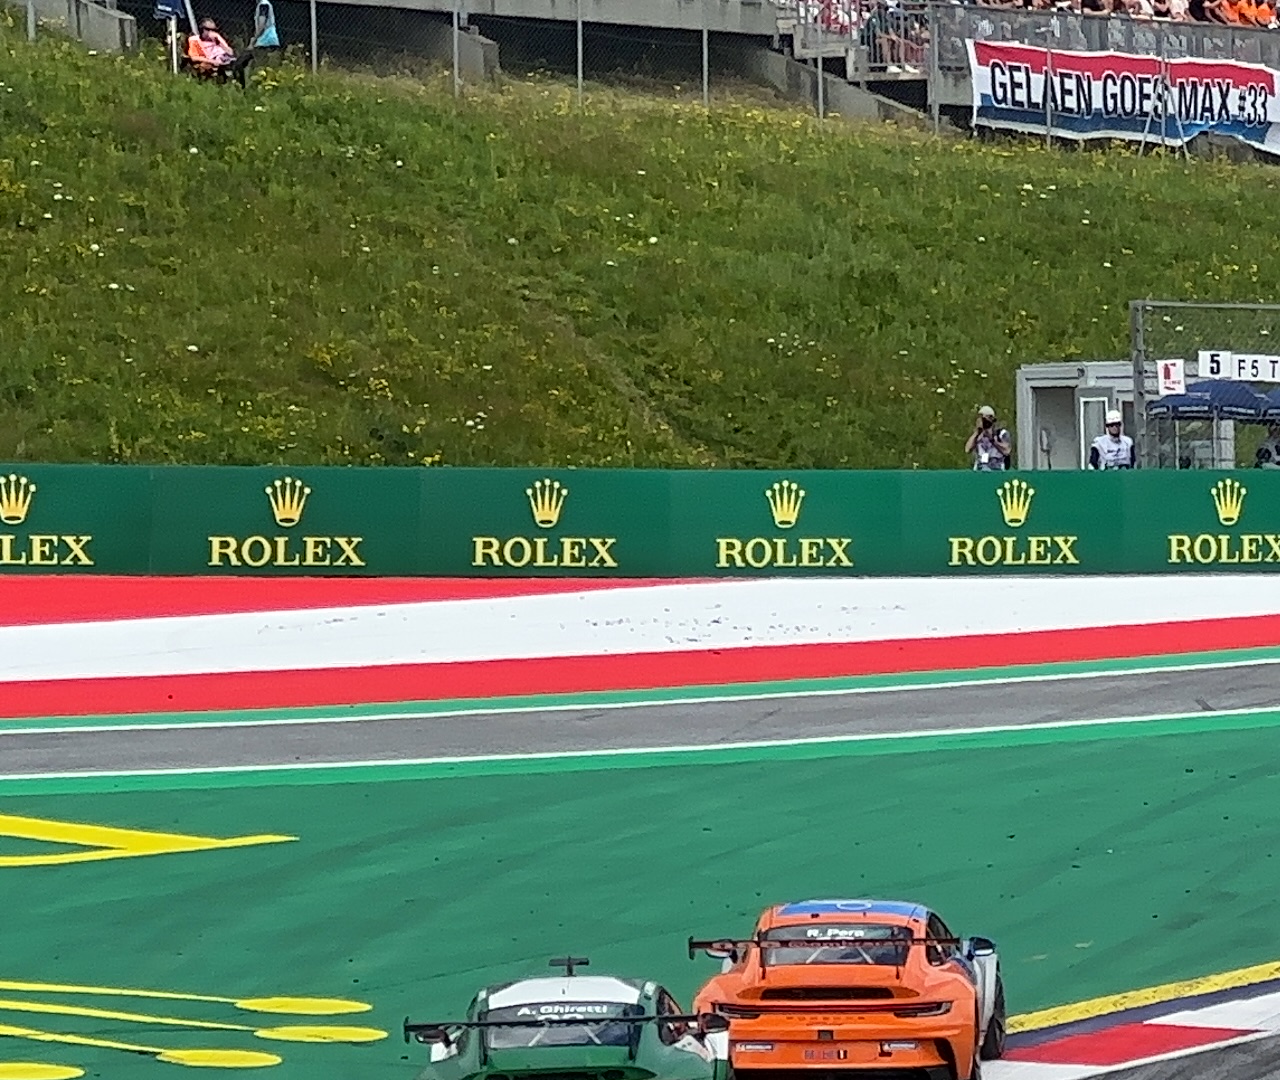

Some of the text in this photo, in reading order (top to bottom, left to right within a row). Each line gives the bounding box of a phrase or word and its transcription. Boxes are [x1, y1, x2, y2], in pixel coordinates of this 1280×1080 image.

[1101, 71, 1164, 121] GOES
[1177, 78, 1231, 123] MAX
[1238, 85, 1268, 126] #33
[1209, 353, 1221, 376] 5
[207, 536, 366, 568] ROLEX
[471, 537, 618, 568] ROLEX
[715, 538, 854, 568] ROLEX
[947, 536, 1080, 566] ROLEX
[806, 927, 865, 938] R. Pera
[517, 1006, 537, 1016] A.
